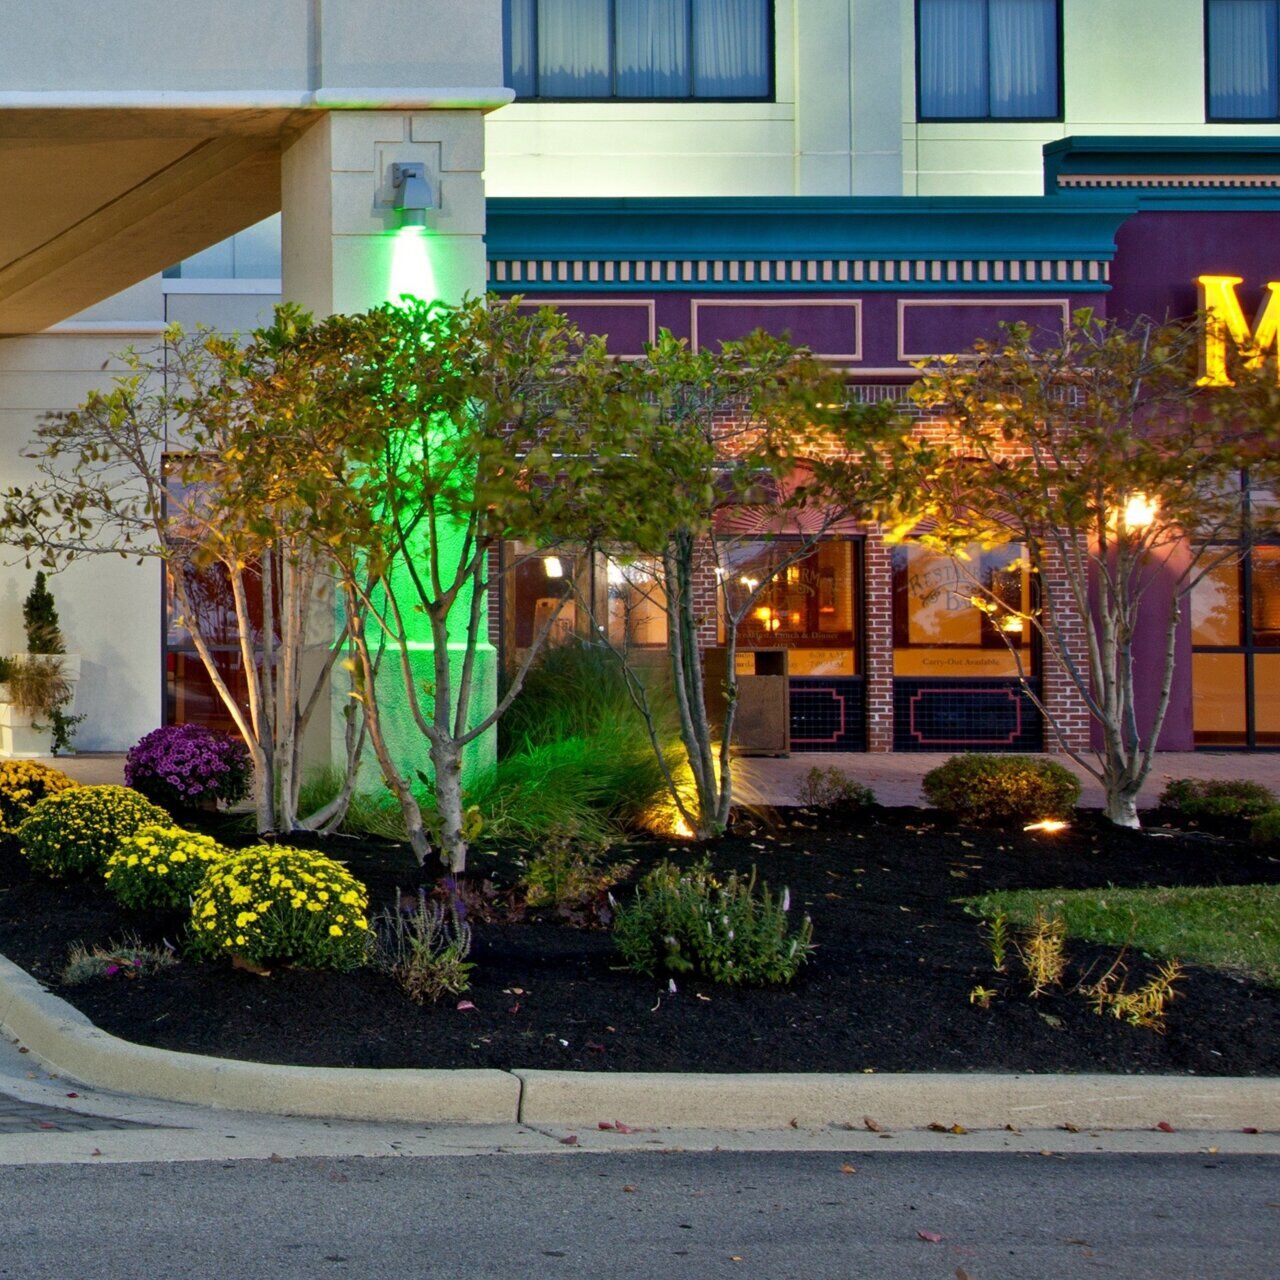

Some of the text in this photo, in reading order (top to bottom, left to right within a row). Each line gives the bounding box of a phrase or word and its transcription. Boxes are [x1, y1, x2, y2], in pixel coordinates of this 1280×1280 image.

[811, 631, 839, 639] Dinner
[922, 657, 1000, 667] Carry-Out Available
